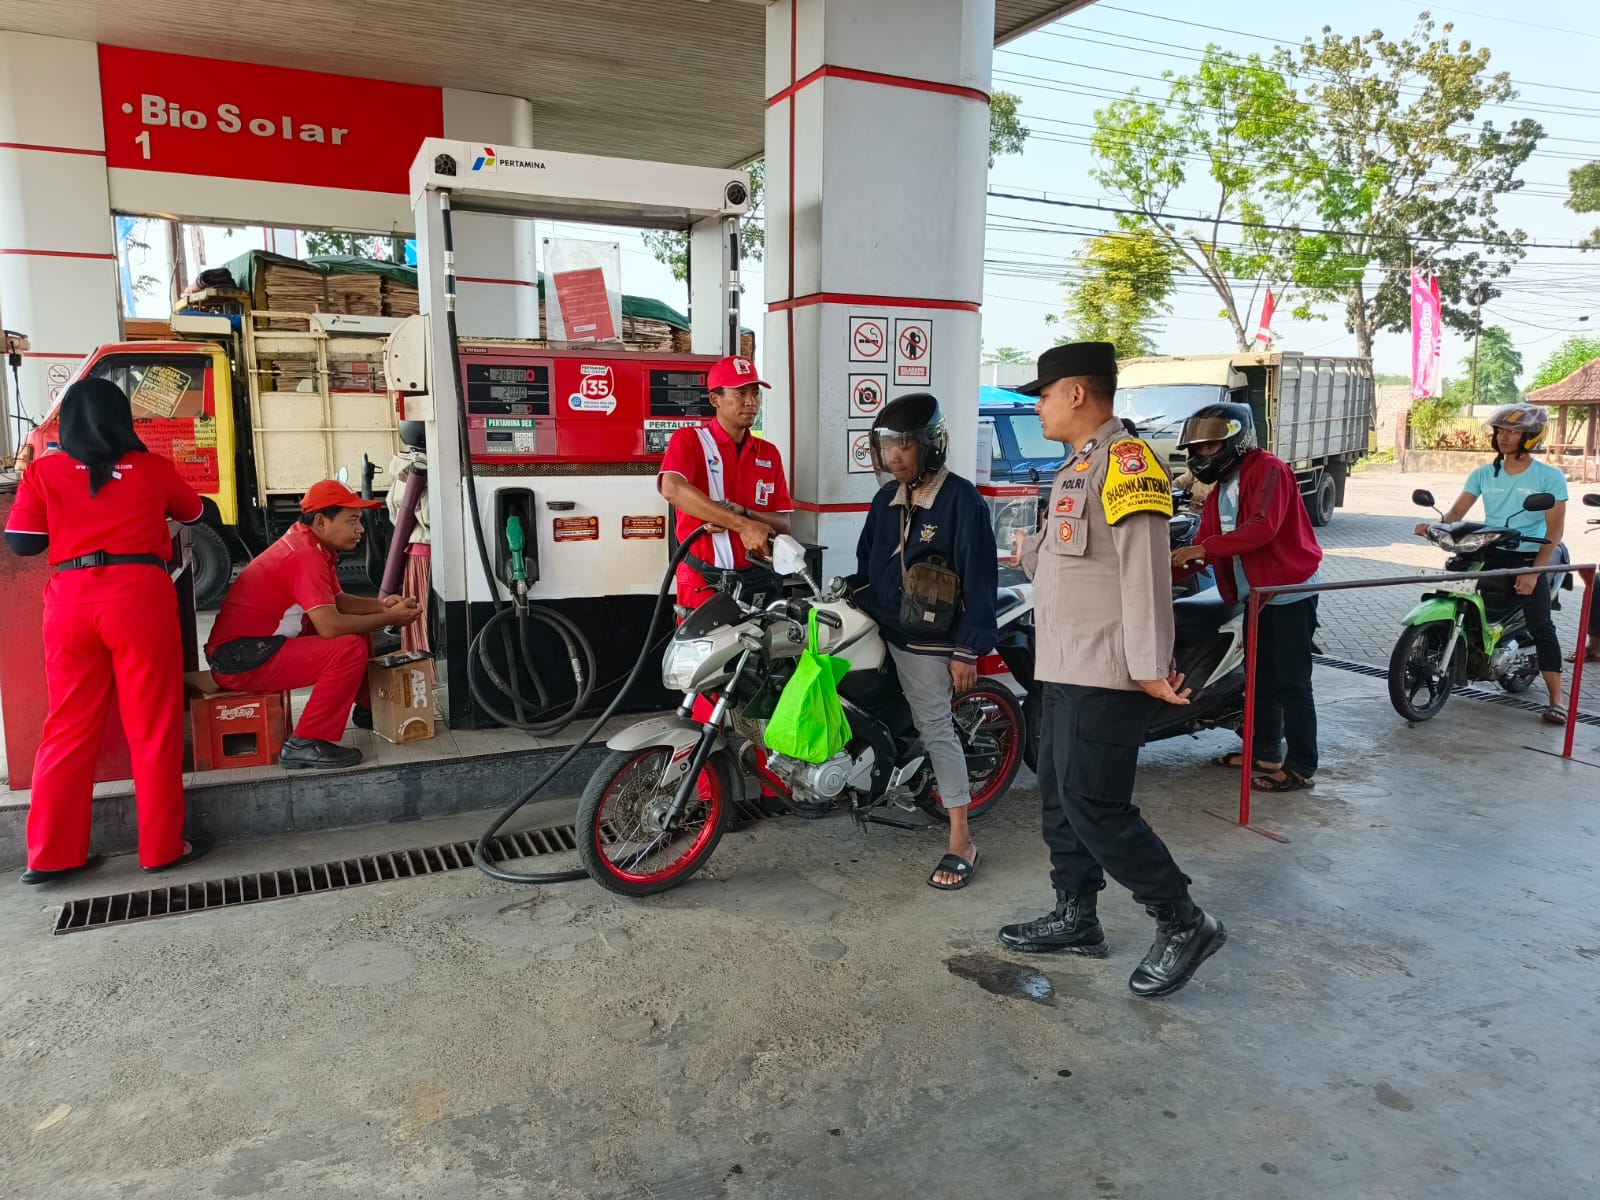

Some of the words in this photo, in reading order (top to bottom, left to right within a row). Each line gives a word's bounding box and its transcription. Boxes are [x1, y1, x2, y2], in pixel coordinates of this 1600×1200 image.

[141, 93, 207, 130] Bio
[217, 103, 349, 145] Solar
[135, 130, 151, 160] 1
[499, 159, 546, 169] PERTAMINA
[582, 379, 609, 396] 135
[488, 419, 520, 427] PERTAMINA
[521, 419, 532, 427] DEX
[649, 421, 697, 429] PERTALITE
[1061, 478, 1086, 490] POLRI
[410, 669, 428, 709] ABC
